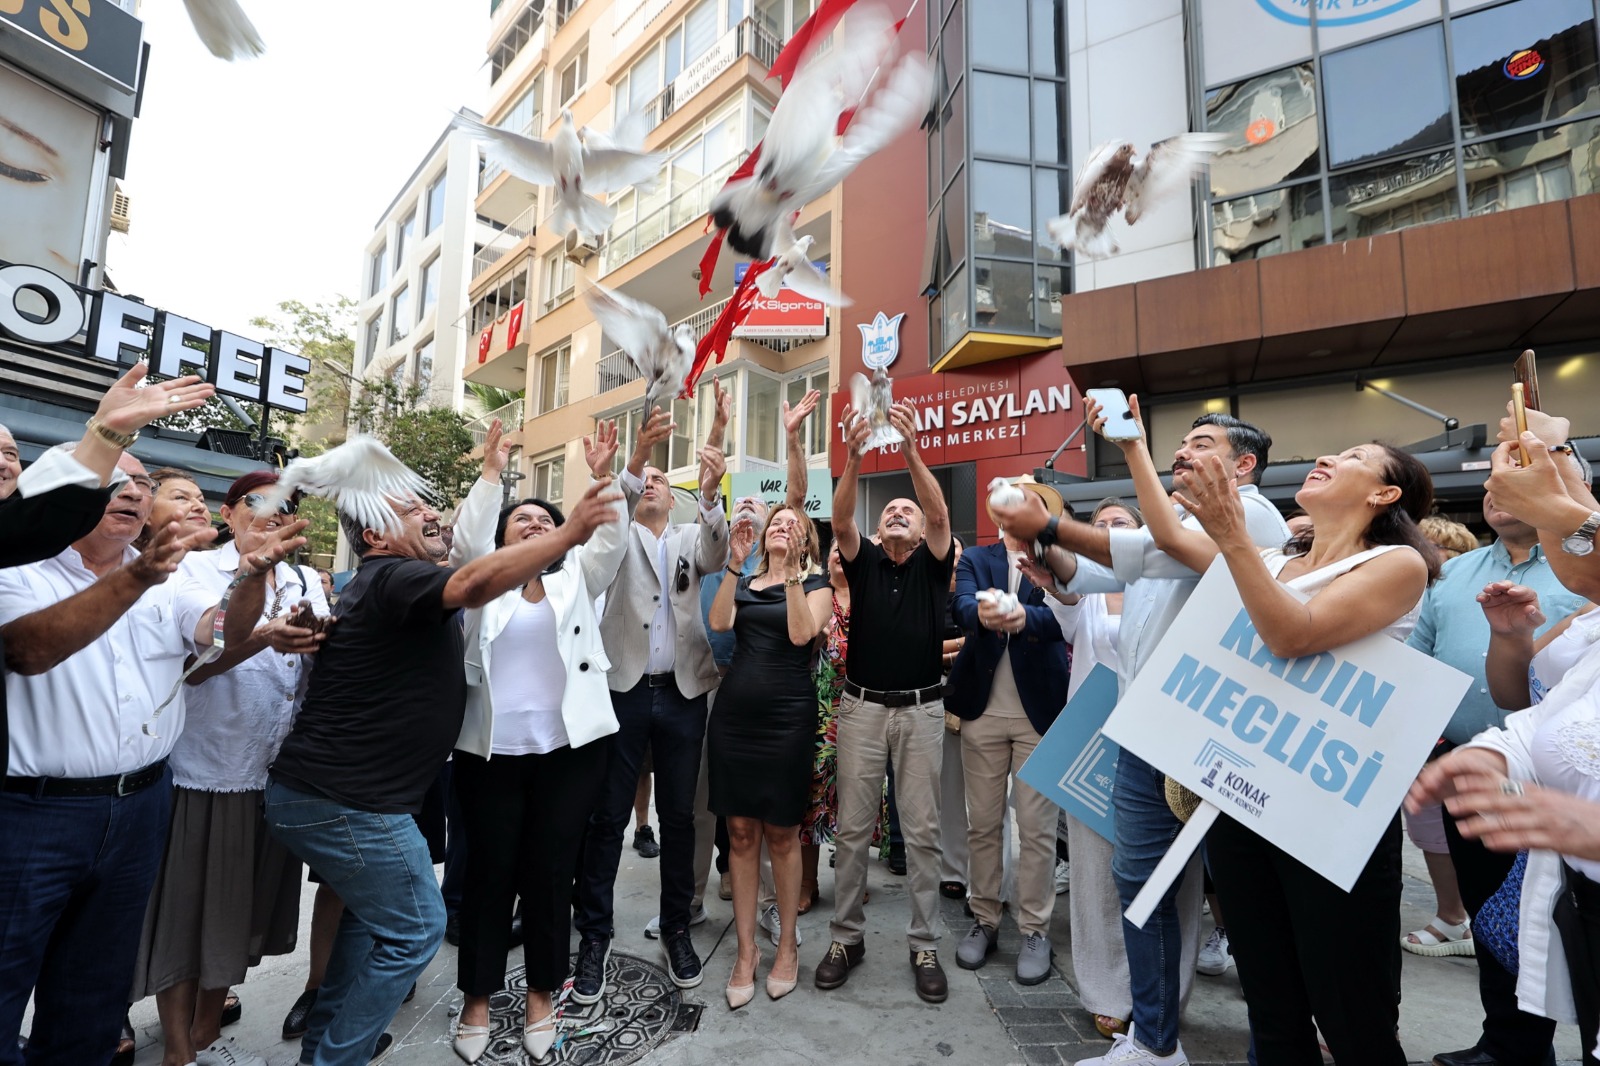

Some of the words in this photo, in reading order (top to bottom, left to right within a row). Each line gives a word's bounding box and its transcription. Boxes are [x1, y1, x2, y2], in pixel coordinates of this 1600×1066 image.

[0, 0, 91, 51] S
[688, 46, 720, 80] AYDEMİR
[1507, 50, 1538, 71] BURGER
[1510, 54, 1542, 78] KING
[676, 81, 701, 105] HUKUK
[702, 51, 734, 84] BÜROSU
[937, 378, 1009, 401] BELEDİYESİ
[951, 383, 1072, 427] SAYLAN
[947, 420, 1027, 446] MERKEZİ
[760, 479, 782, 493] VAR
[1219, 608, 1396, 728] KADIN
[1160, 653, 1385, 808] MECLİSİ
[1218, 785, 1235, 801] KENT
[1233, 796, 1263, 818] KONSEYİ
[1224, 771, 1271, 808] KONAK
